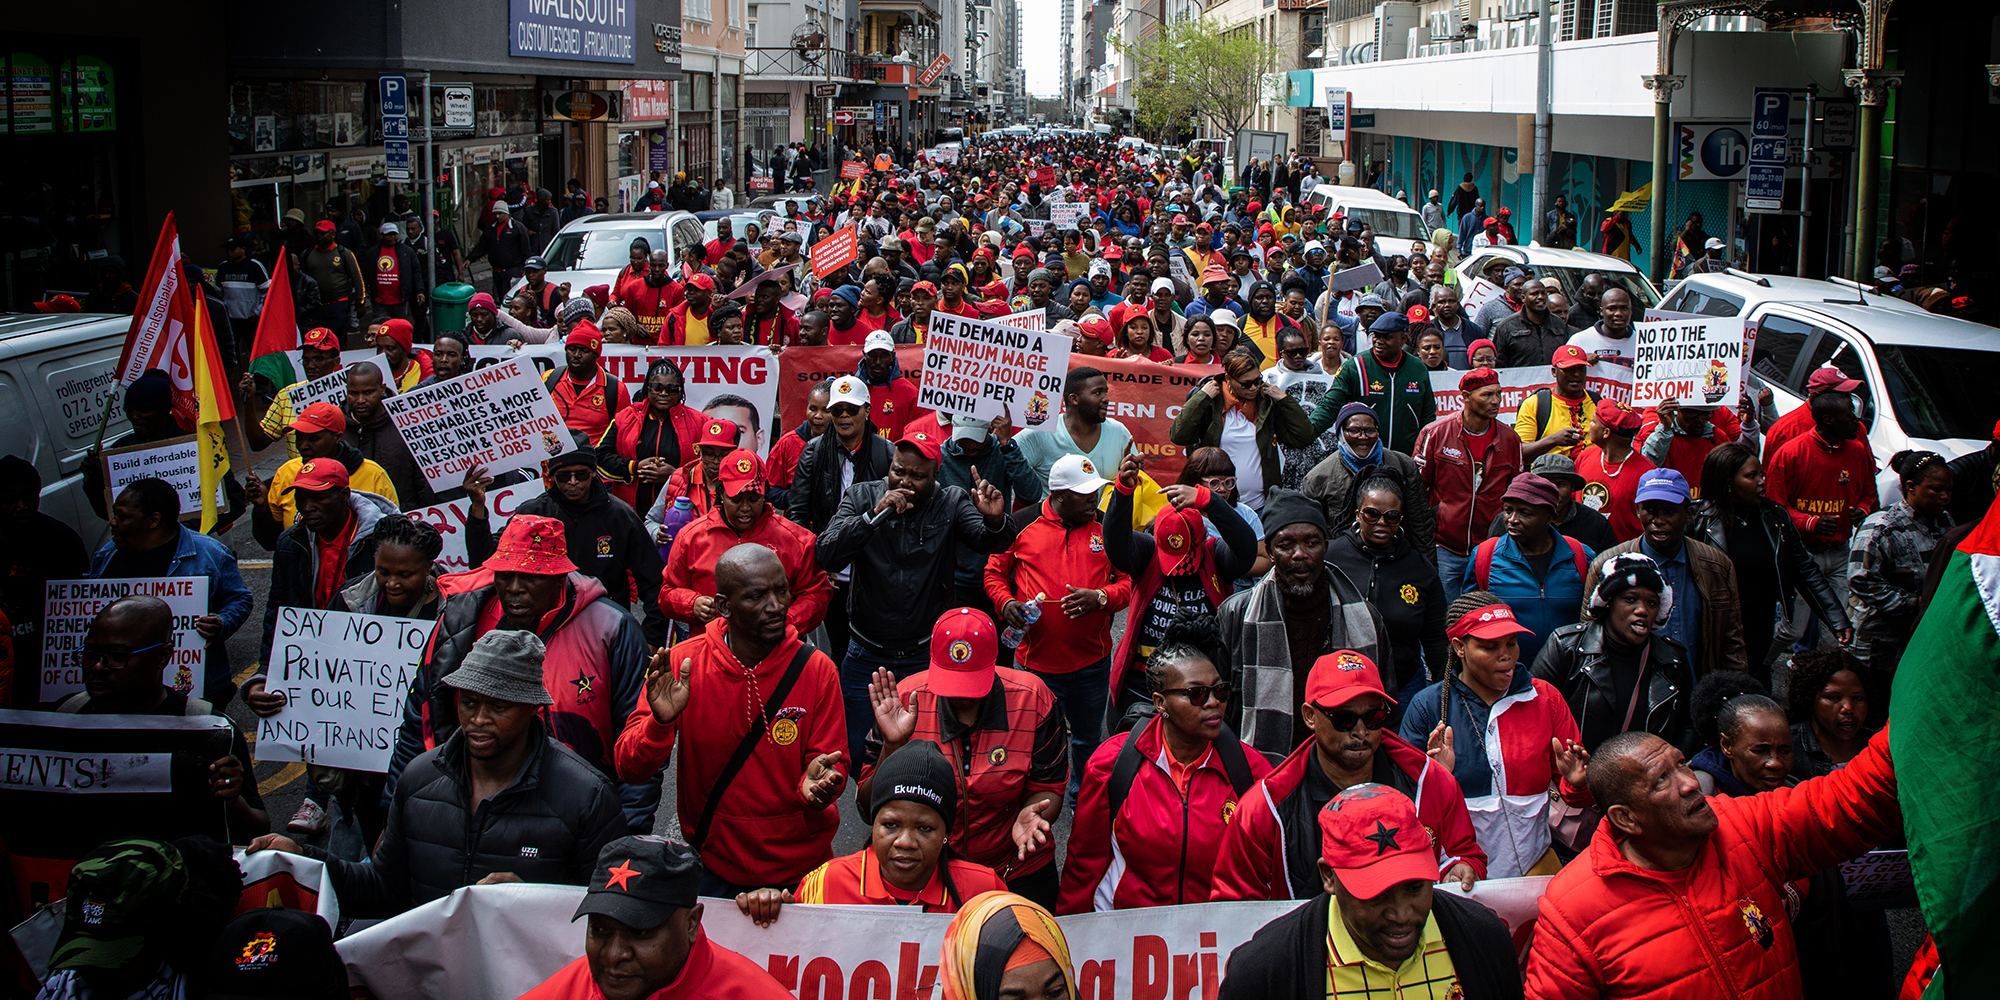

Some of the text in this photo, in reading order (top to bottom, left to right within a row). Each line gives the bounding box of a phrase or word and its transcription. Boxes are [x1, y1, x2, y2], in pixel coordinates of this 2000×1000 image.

[518, 22, 632, 58] CUSTOM DESIGNED AFRICAN CULTURE
[386, 80, 398, 97] P
[575, 92, 588, 103] M
[384, 101, 392, 109] 60
[633, 96, 669, 117] & Mini Market
[1763, 97, 1780, 115] P
[1756, 121, 1768, 130] 60
[1720, 137, 1746, 165] ih
[932, 316, 1043, 352] WE DEMAND A
[1638, 326, 1707, 344] NO TO THE
[929, 334, 1048, 372] MINIMUM WAGE
[1637, 342, 1740, 361] PRIVATISATION
[927, 353, 1061, 393] OF R72/HOUR OR
[1104, 372, 1163, 385] TRADE
[1636, 364, 1652, 379] OF
[1655, 362, 1674, 379] OUR
[289, 388, 306, 404] WE
[306, 370, 349, 397] DEMAN
[387, 401, 405, 415] WE
[407, 382, 464, 408] DEMAND
[464, 363, 521, 390] CLIMATE
[923, 370, 980, 395] R12500
[983, 382, 1015, 403] PER
[1586, 382, 1632, 403] HEALTH
[1634, 381, 1694, 400] ESKOM!
[62, 397, 90, 419] 072
[396, 389, 490, 428] JUSTICE: MORE
[920, 388, 976, 413] MONTH
[401, 388, 542, 441] RENEWABLES & MORE
[408, 406, 534, 454] PUBLIC INVESTMENT
[416, 414, 560, 467] IN ESKOM & CREATION
[112, 450, 196, 471] Build affordable
[425, 439, 532, 480] OF CLIMATE JOBS
[155, 465, 196, 479] housing
[172, 480, 192, 490] obs!
[1797, 498, 1844, 512] MAYDAY
[48, 581, 193, 599] WE DEMAND CLIMATE
[173, 616, 199, 630] ORE
[282, 607, 425, 649] SAY NO TO
[44, 653, 60, 668] IN
[44, 670, 61, 684] OF
[271, 687, 301, 707] OF
[312, 688, 356, 710] OUR
[577, 695, 596, 706] SACP
[261, 720, 309, 741] AND
[301, 744, 315, 763] !!
[894, 784, 943, 804] Ekurhuleni
[235, 954, 279, 964] SAFTU
